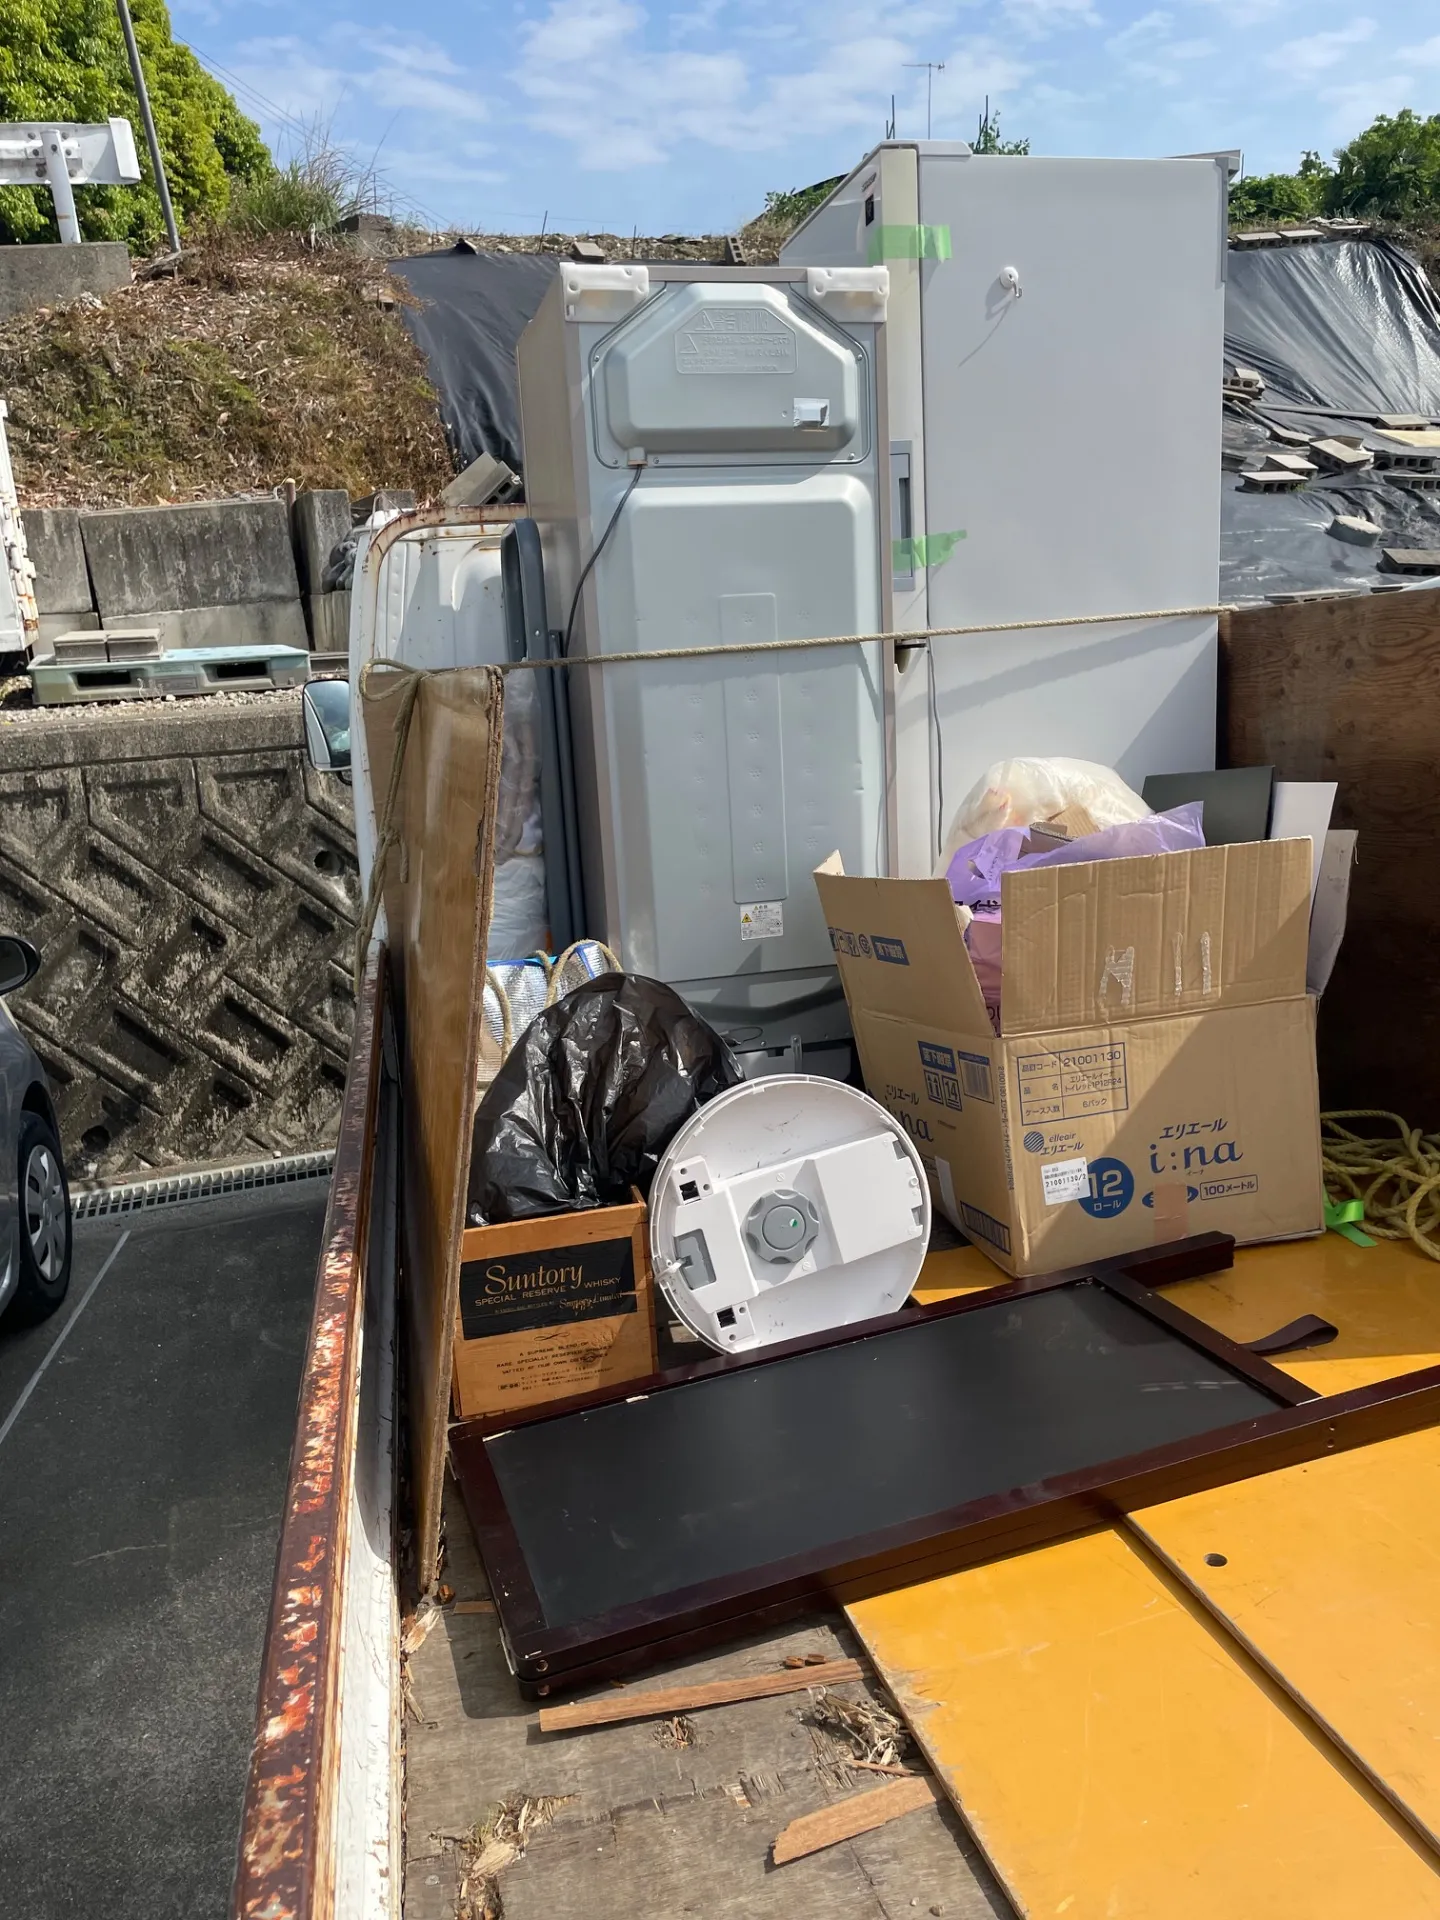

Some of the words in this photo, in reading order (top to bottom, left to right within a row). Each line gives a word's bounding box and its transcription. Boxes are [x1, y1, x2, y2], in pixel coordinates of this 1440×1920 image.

[1063, 1050, 1121, 1067] 21001130
[1049, 1132, 1077, 1143] elleair
[1159, 1118, 1228, 1140] エリエール
[1040, 1141, 1085, 1156] エリエール
[1149, 1140, 1244, 1174] i:na
[1088, 1169, 1124, 1199] 12
[1203, 1180, 1255, 1196] 100メートル
[1093, 1199, 1122, 1212] ロール
[484, 1264, 583, 1295] Suntory
[475, 1294, 517, 1307] SPECIAL
[522, 1286, 567, 1299] RESERVE
[583, 1276, 621, 1289] WHISKY
